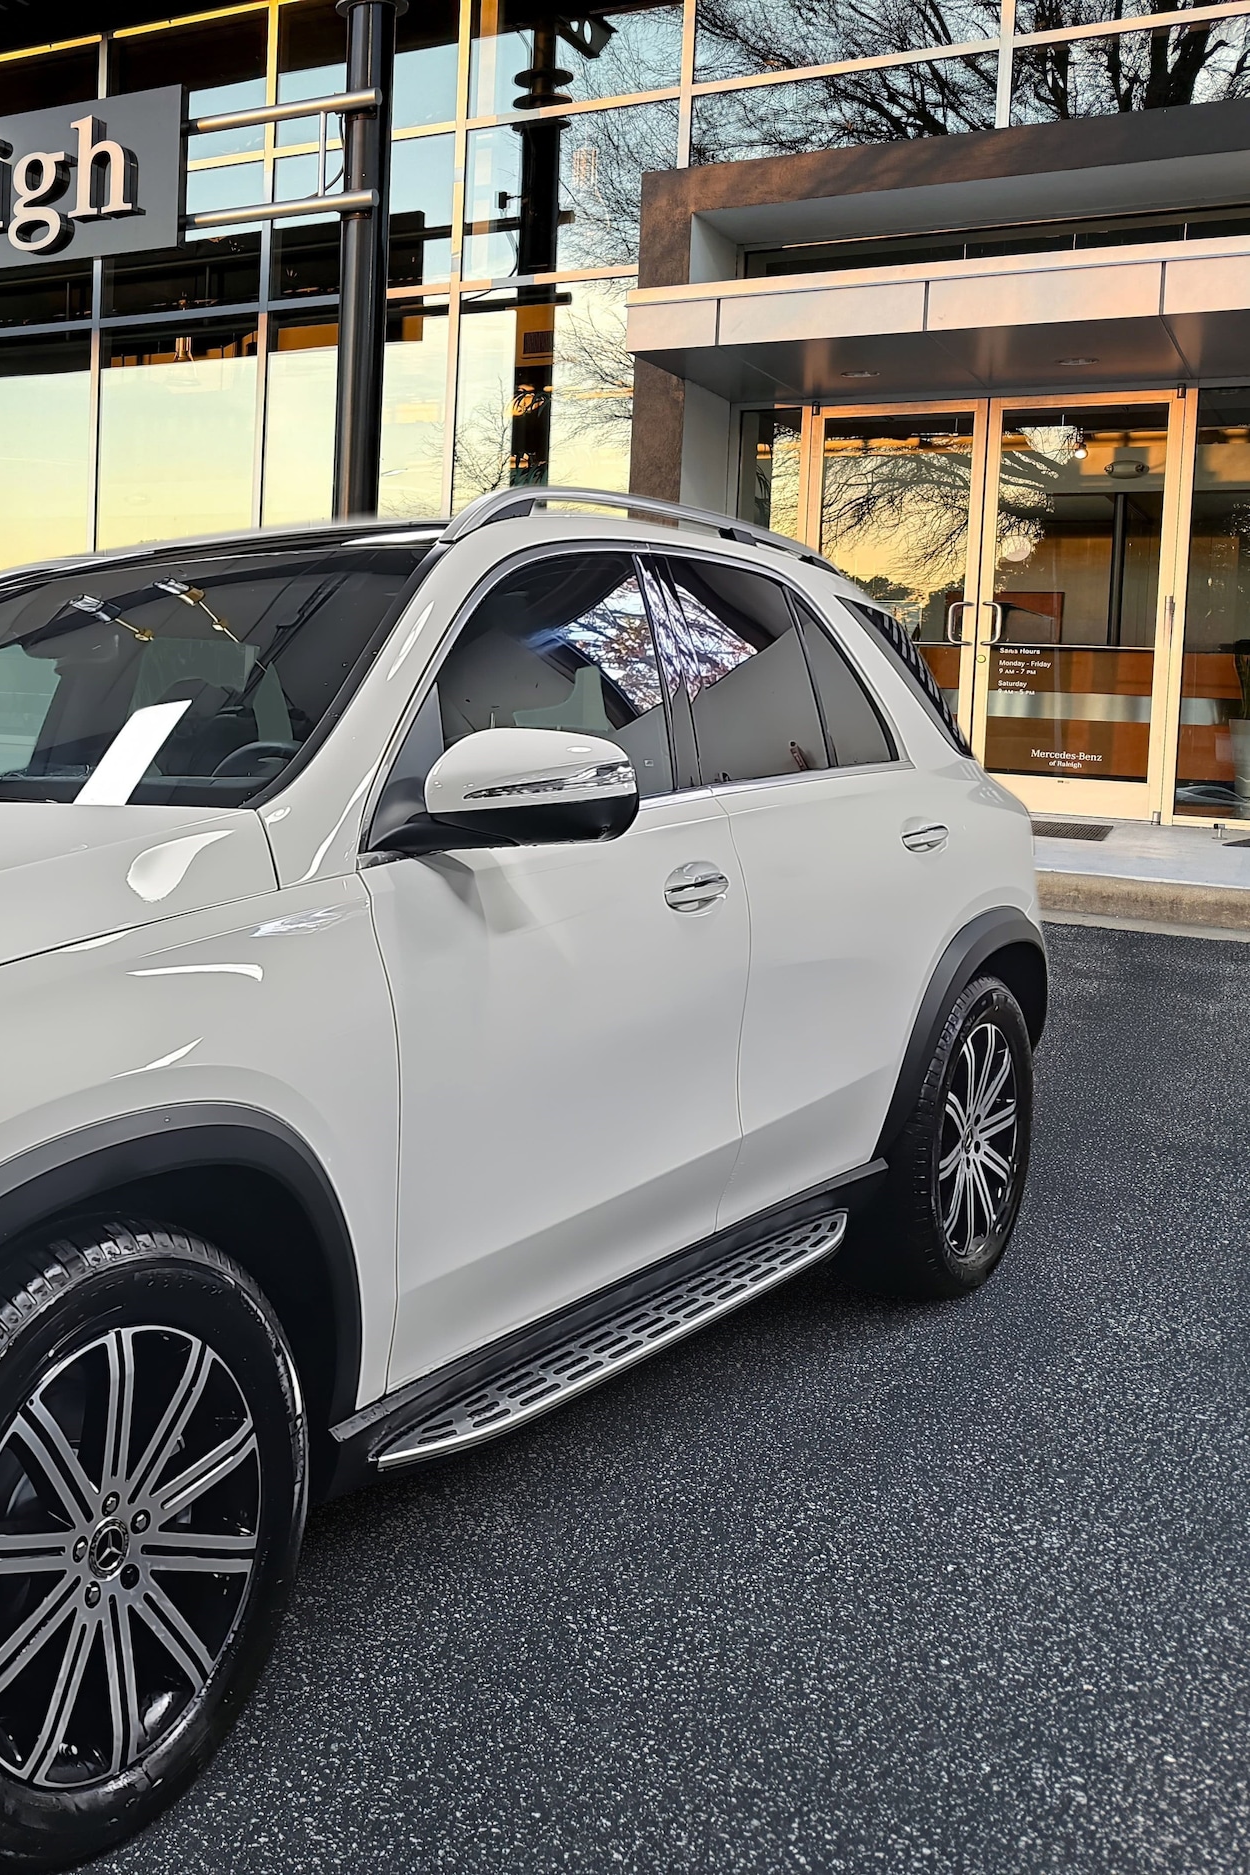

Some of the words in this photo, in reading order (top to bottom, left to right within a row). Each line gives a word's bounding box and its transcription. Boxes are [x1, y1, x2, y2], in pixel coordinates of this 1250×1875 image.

[998, 659, 1026, 668] Monday
[1030, 660, 1052, 669] Friday
[997, 680, 1028, 688] Saturday
[1030, 748, 1103, 762] Mercedes-Benz
[1056, 760, 1083, 769] Raleigh
